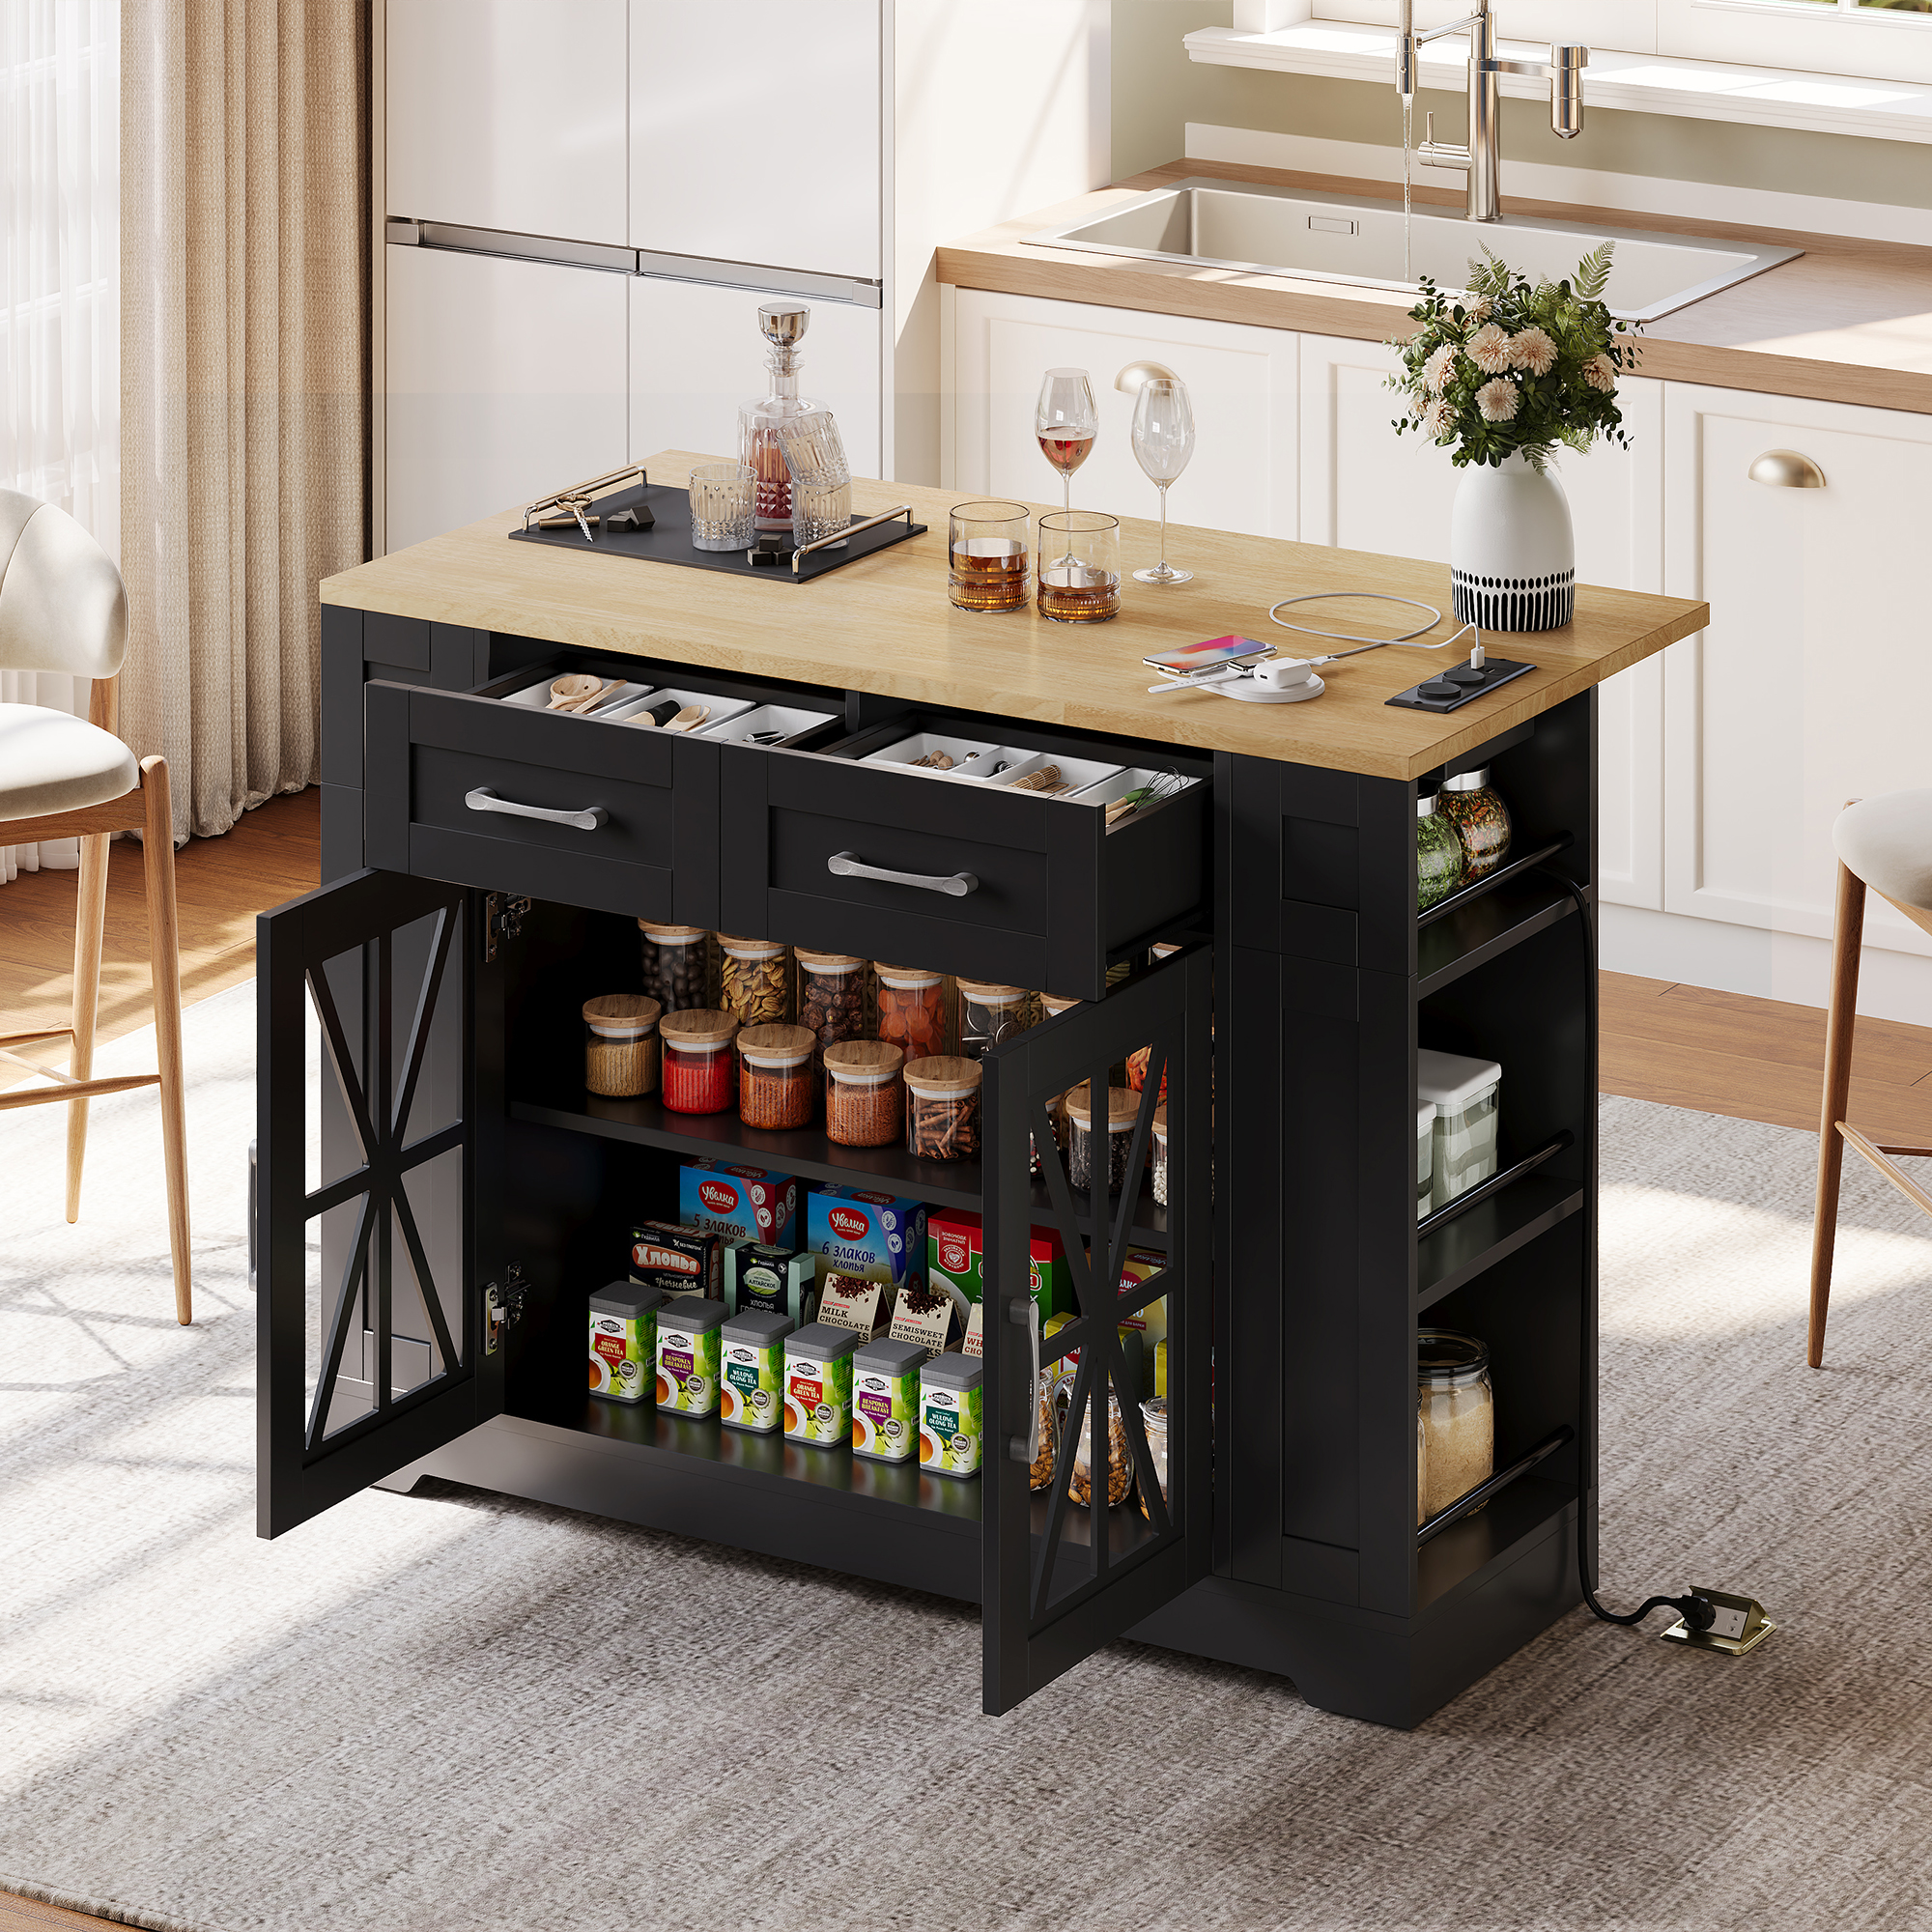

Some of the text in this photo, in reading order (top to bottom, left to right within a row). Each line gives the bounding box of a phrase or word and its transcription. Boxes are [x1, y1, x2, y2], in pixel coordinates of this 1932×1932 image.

[701, 1185, 734, 1206] Увелка
[693, 1213, 701, 1228] 5
[832, 1212, 866, 1233] Увелка
[822, 1241, 830, 1255] 6
[636, 1245, 697, 1272] Хлопья
[833, 1259, 866, 1273] хлопья
[750, 1298, 775, 1310] ХЛОПЬЯ
[821, 1305, 848, 1319] MILK
[819, 1315, 870, 1331] CHOCOLATE
[893, 1322, 945, 1340] SEMISWEET
[601, 1340, 620, 1350] ORANGE
[891, 1331, 943, 1348] CHOCOLATE
[597, 1345, 613, 1353] GREEN
[793, 1388, 810, 1397] GREEN
[796, 1383, 816, 1393] ORANGE
